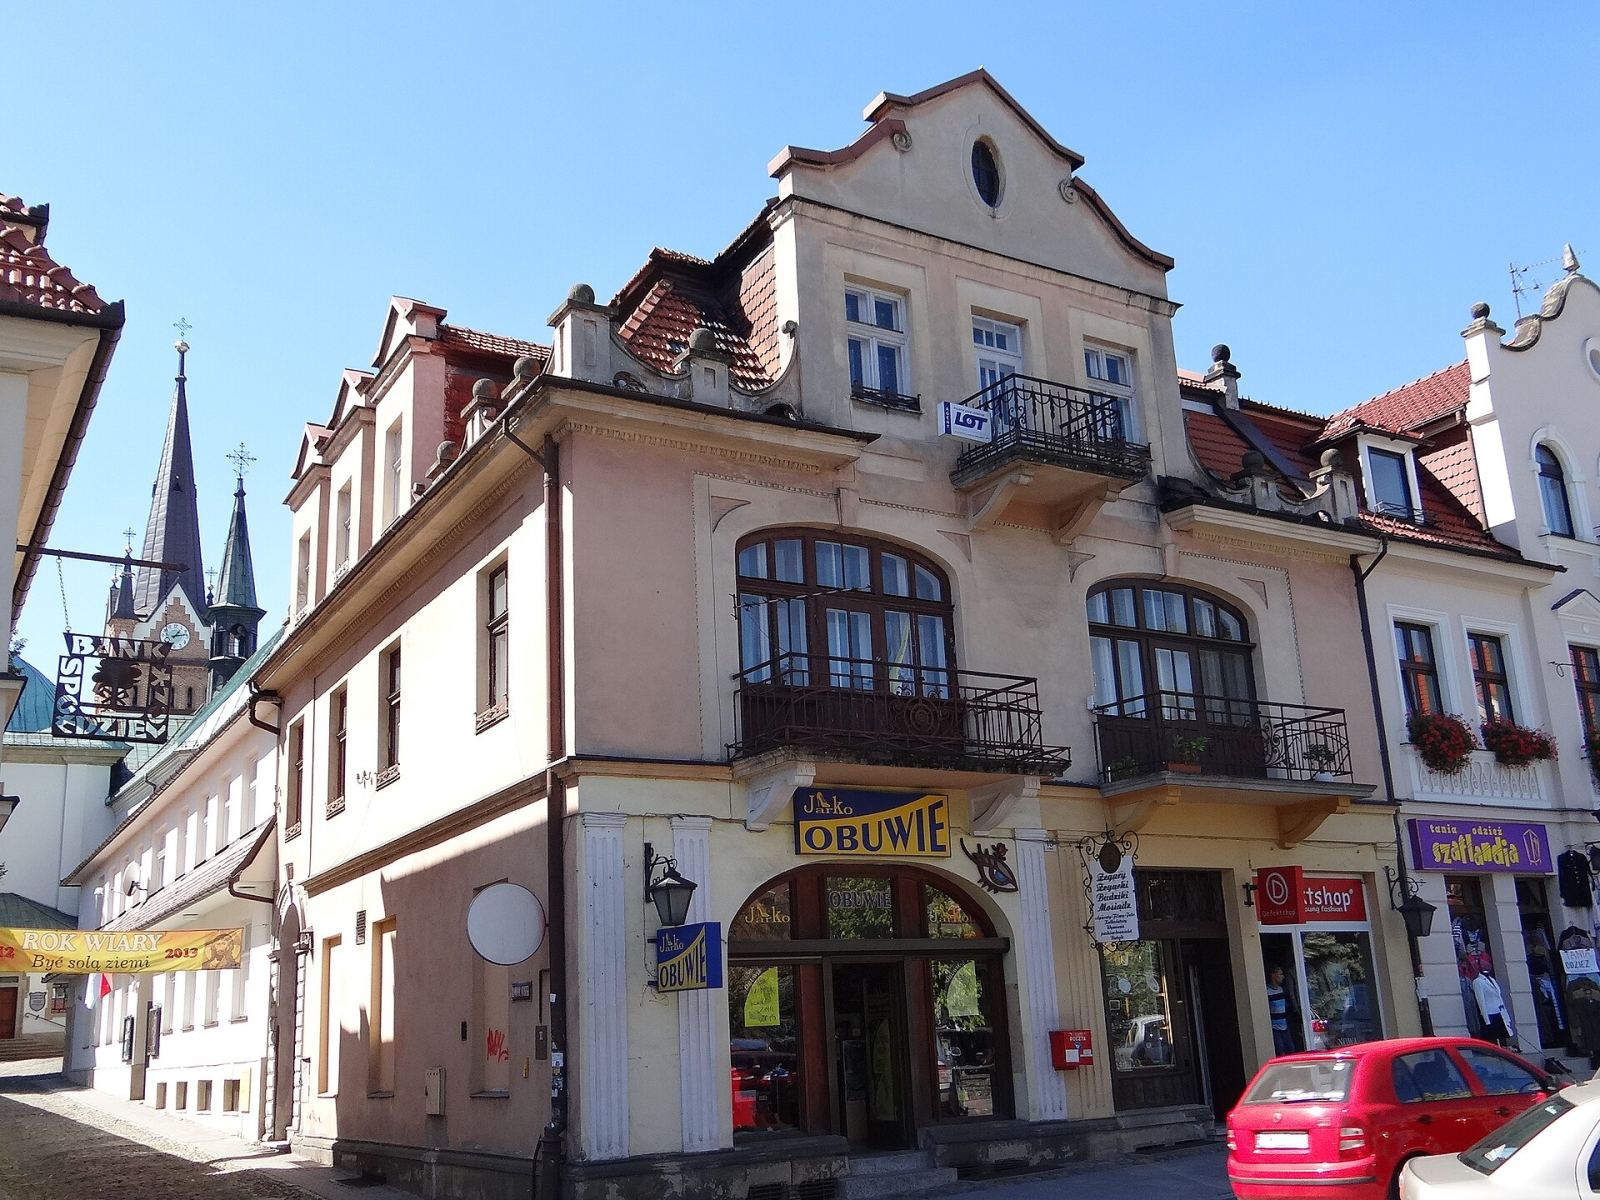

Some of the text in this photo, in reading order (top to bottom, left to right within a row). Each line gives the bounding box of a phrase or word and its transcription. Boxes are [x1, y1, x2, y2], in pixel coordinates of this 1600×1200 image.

[955, 411, 988, 430] LOT
[71, 635, 166, 659] BANK
[803, 794, 853, 815] Jarko
[804, 799, 947, 852] OBUWIE
[1429, 824, 1457, 834] tania
[1432, 833, 1520, 867] szaflandia
[1096, 872, 1127, 882] Zegary
[1096, 881, 1129, 892] Zegarki
[828, 890, 892, 909] OBUWIE
[1098, 900, 1132, 912] Mosiądz
[1321, 905, 1344, 913] fashion
[22, 932, 164, 952] ROK WIARY
[164, 947, 199, 959] 2013
[660, 936, 706, 988] OBUWIE
[32, 954, 150, 972] Być solą ziemi
